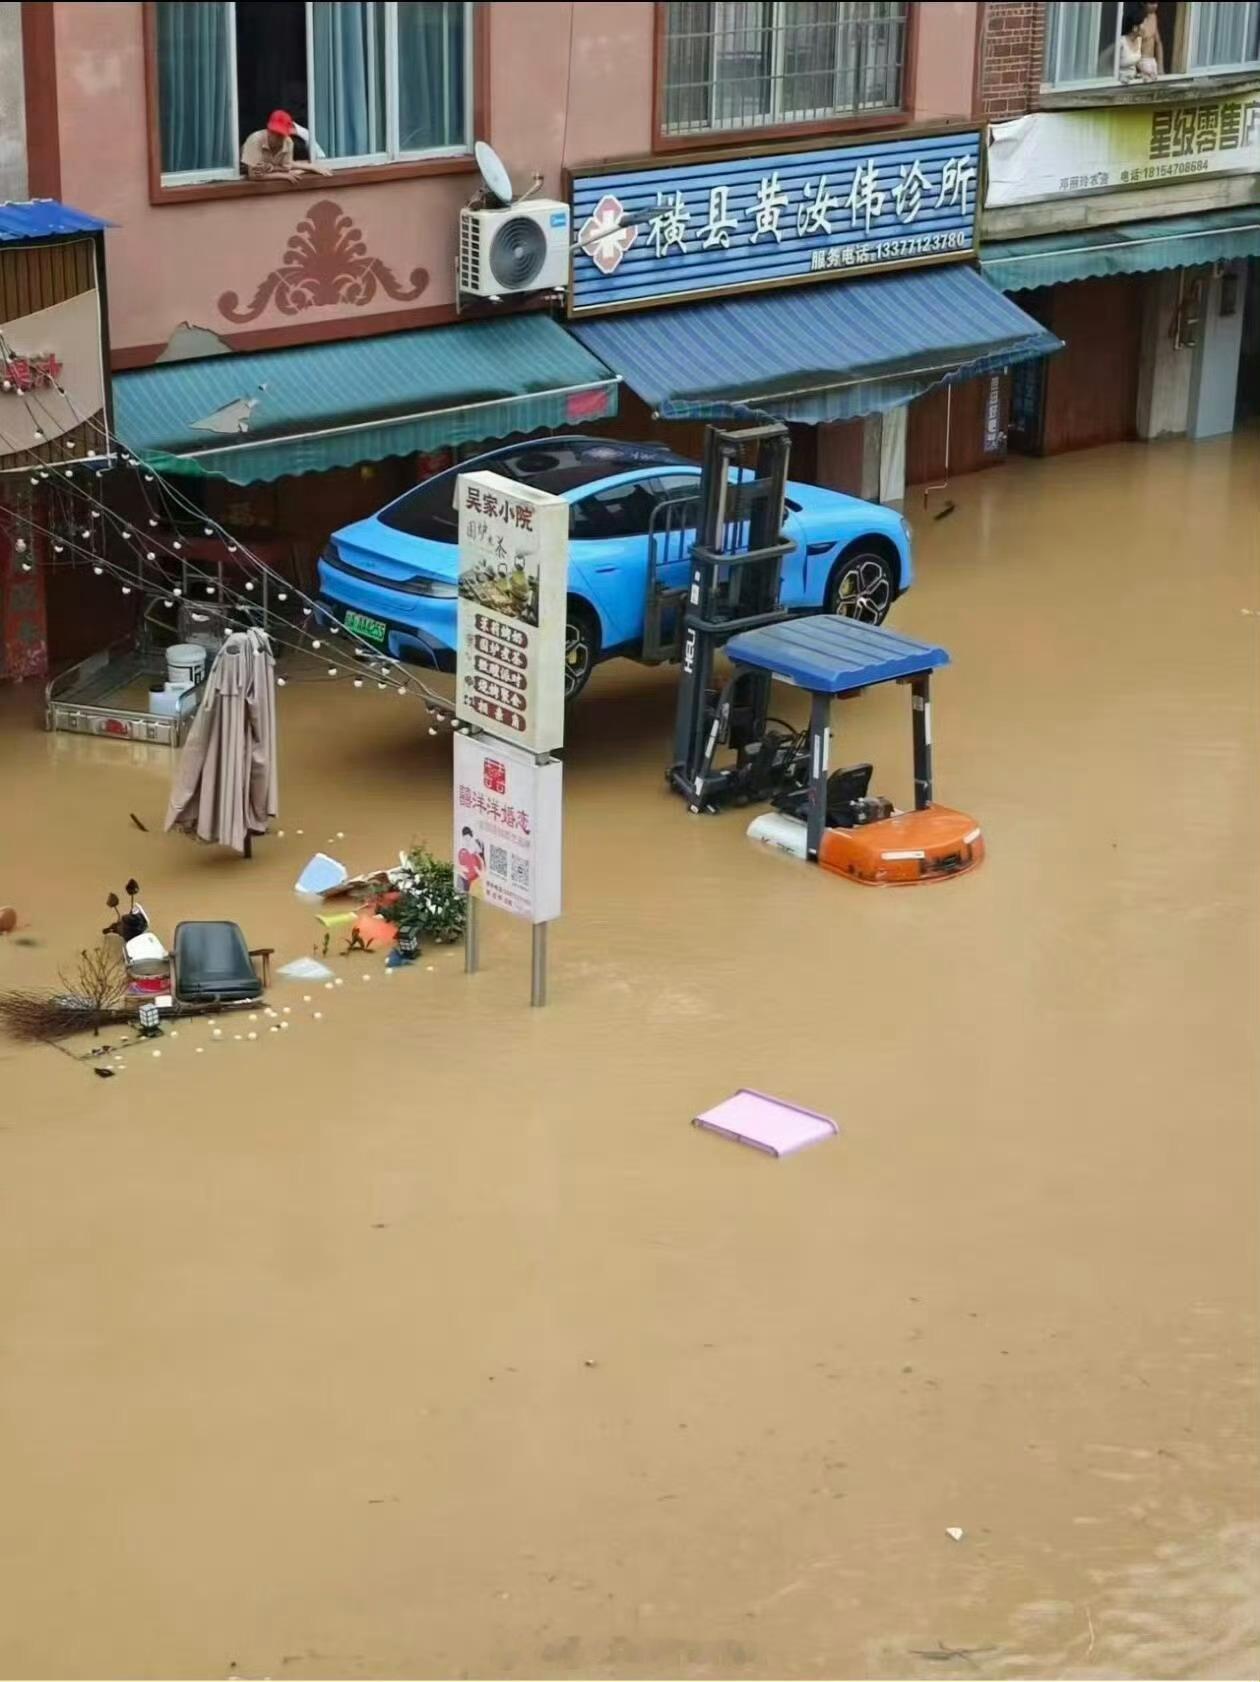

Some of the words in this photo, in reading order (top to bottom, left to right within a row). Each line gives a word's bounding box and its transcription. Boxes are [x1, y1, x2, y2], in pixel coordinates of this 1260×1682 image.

[646, 154, 976, 258] 横县黄汝伟诊所
[464, 486, 534, 532] 吴家小院
